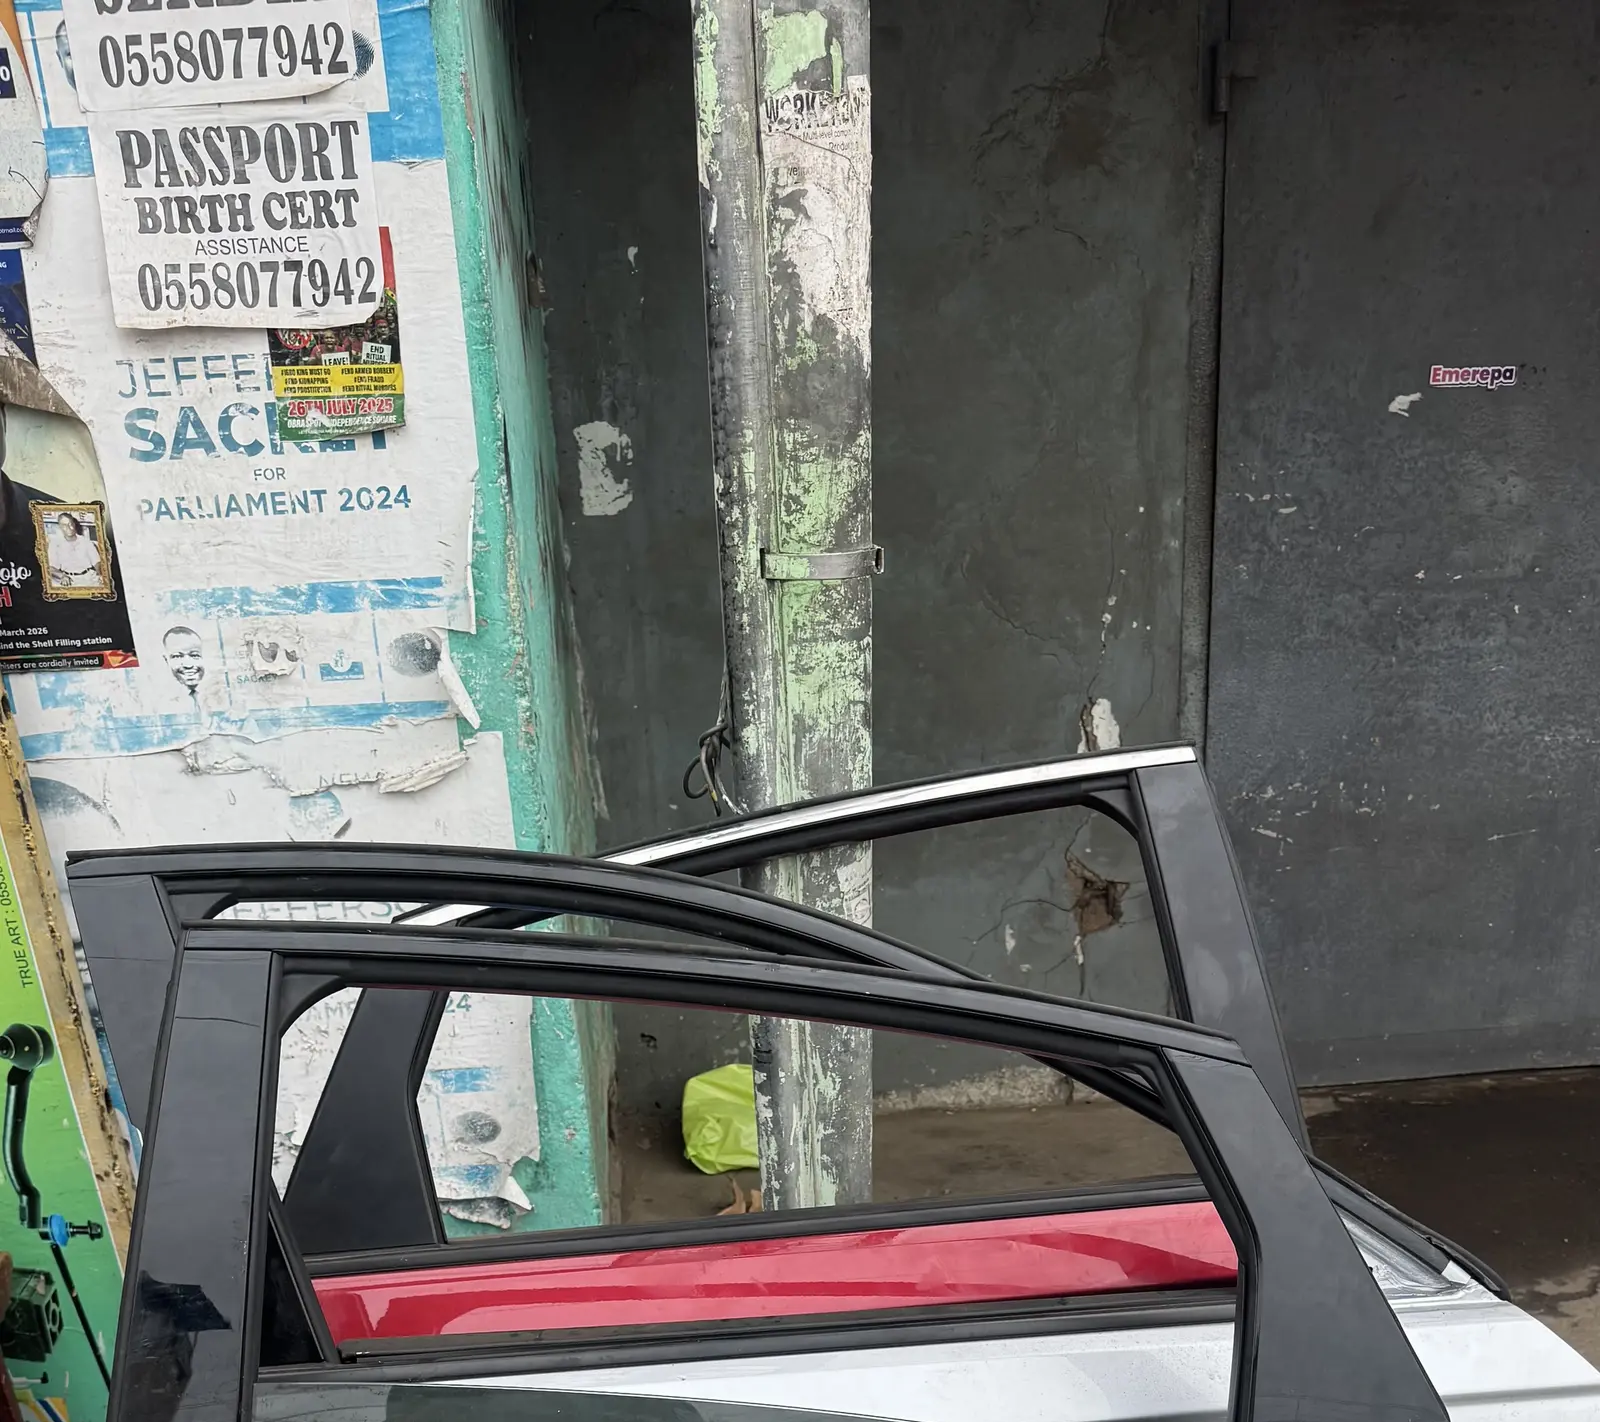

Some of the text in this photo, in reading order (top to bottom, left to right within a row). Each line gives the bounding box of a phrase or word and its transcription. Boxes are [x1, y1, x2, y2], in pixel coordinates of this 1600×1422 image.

[99, 22, 349, 88] 0558077942
[115, 120, 360, 188] PASSPORT
[134, 188, 359, 234] BIRTH CERT
[195, 235, 310, 256] ASSISTANCE
[137, 256, 377, 312] 0558077942
[370, 345, 384, 354] END
[1430, 365, 1516, 388] Emerepa
[326, 398, 358, 416] JULY
[358, 396, 394, 414] 2025
[123, 402, 388, 463] SAC
[253, 466, 287, 481] FOR
[139, 485, 412, 522] PARLIAMENT 2024
[15, 641, 31, 649] the
[32, 639, 54, 648] Shell
[55, 638, 82, 648] Filling
[82, 636, 113, 645] station
[27, 627, 49, 636] 2026
[5, 918, 24, 947] ART
[14, 950, 34, 988] TRUE
